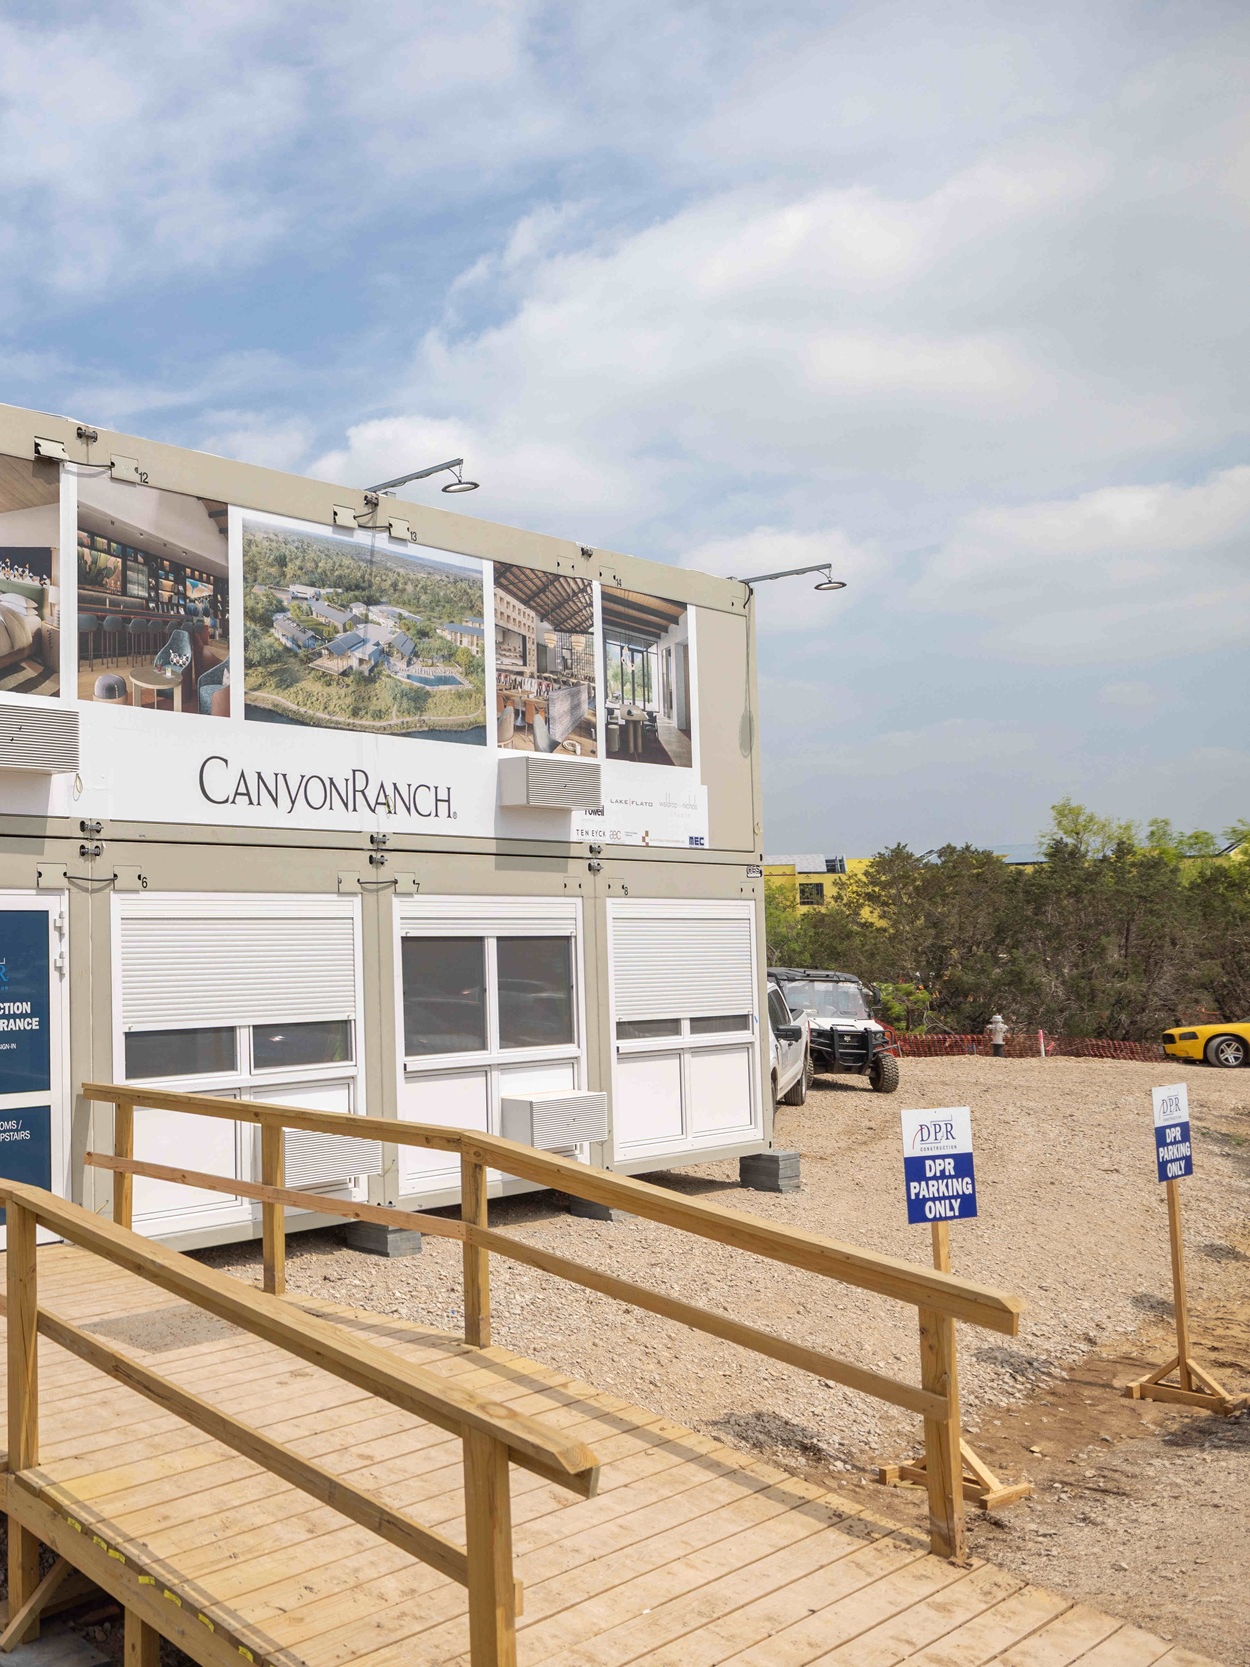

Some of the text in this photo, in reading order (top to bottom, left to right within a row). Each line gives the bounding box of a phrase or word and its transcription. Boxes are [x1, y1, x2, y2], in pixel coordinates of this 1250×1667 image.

[139, 472, 148, 484] 12
[410, 531, 417, 541] 13
[142, 876, 148, 888] 6
[415, 883, 420, 892] 7
[624, 886, 628, 895] 8
[1162, 1097, 1181, 1114] DPR
[919, 1123, 956, 1142] DPR
[1166, 1127, 1181, 1143] DPR
[1159, 1142, 1190, 1162] PARKING
[925, 1158, 955, 1177] DPR
[1167, 1160, 1185, 1177] ONLY
[910, 1177, 972, 1199] PARKING
[925, 1199, 961, 1219] ONLY
